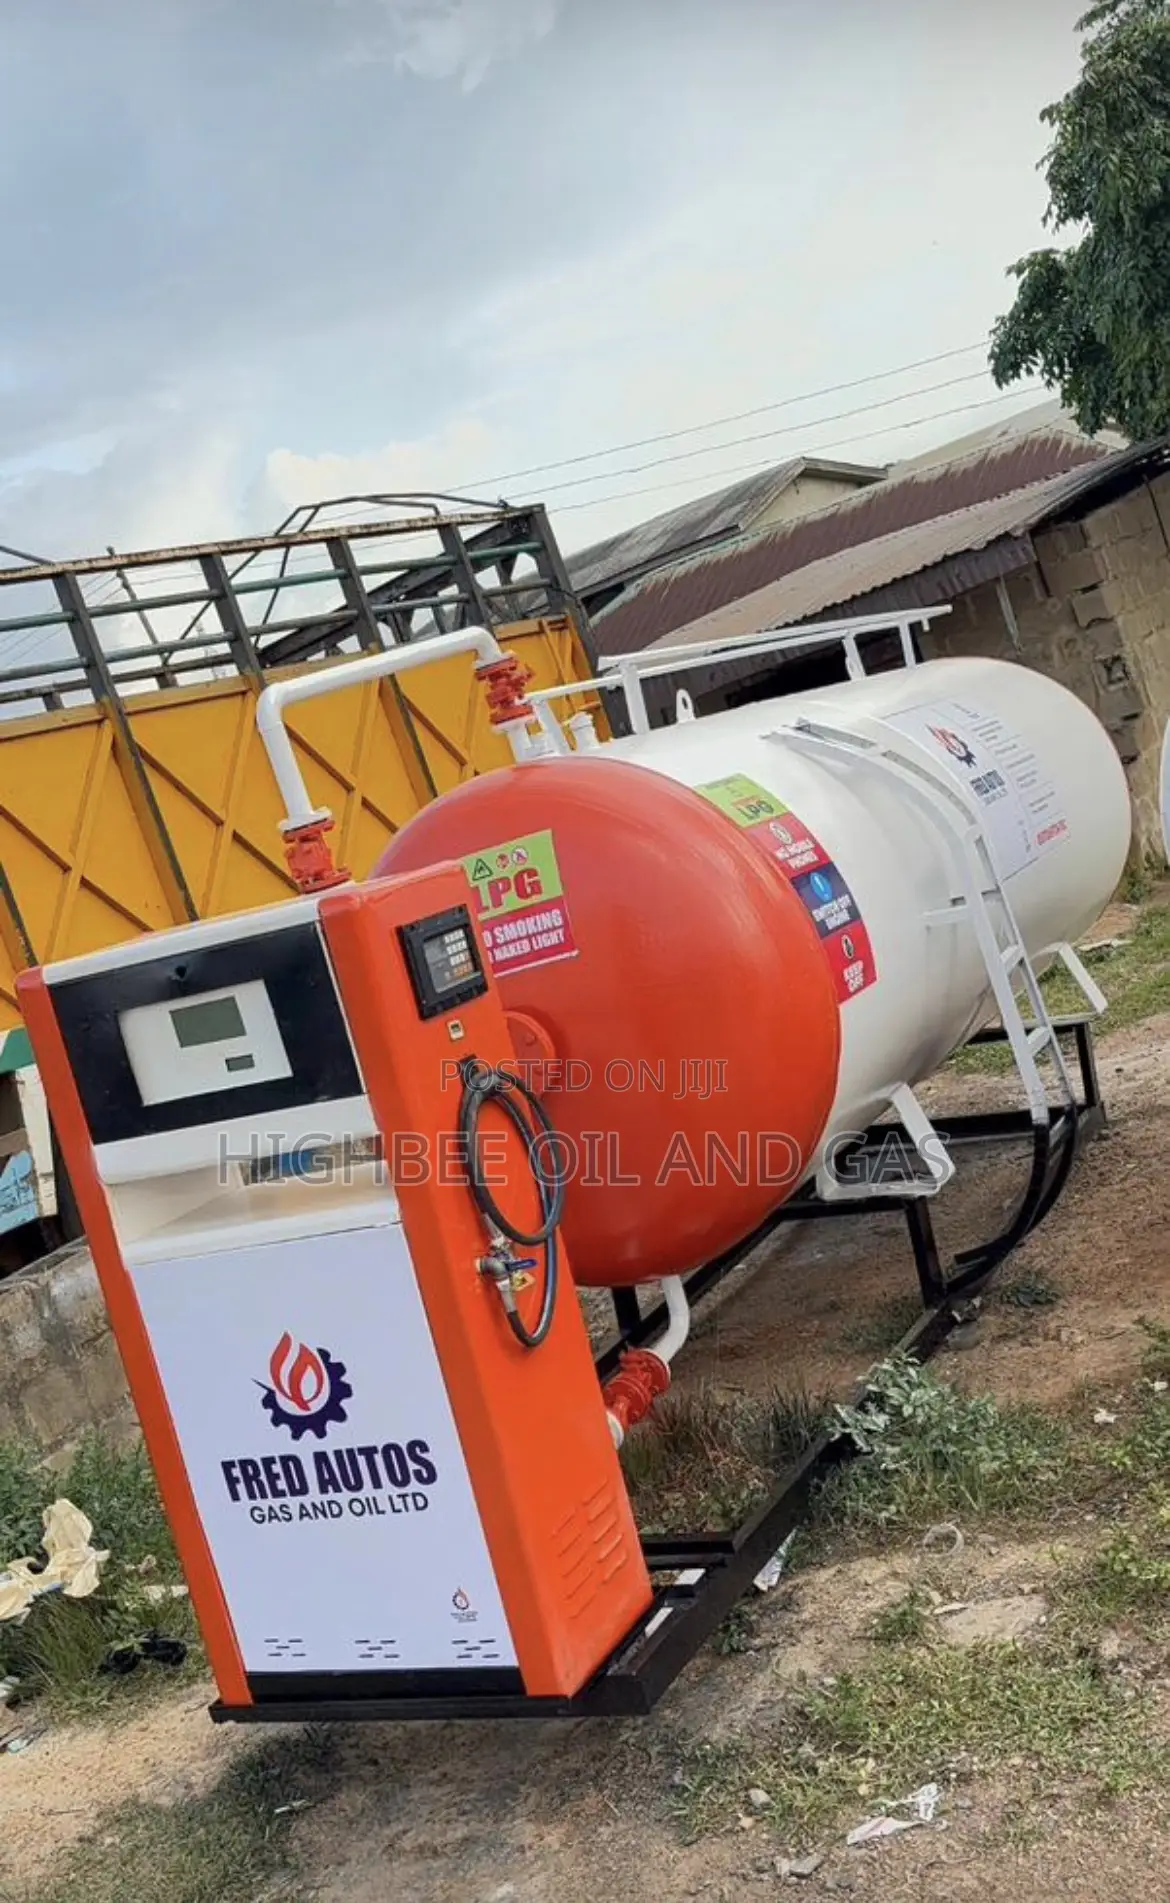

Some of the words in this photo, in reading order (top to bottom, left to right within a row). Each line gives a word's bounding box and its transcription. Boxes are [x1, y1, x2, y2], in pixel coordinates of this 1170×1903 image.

[482, 929, 493, 946] O
[494, 908, 564, 945] SMOKING
[493, 940, 532, 962] NAKED
[531, 928, 566, 950] LIGHT
[221, 1454, 309, 1502] FRED
[313, 1439, 438, 1494] AUTOS
[250, 1503, 293, 1525] GAS
[298, 1499, 344, 1522] AND
[347, 1496, 386, 1518] OIL
[388, 1492, 429, 1514] LTD
